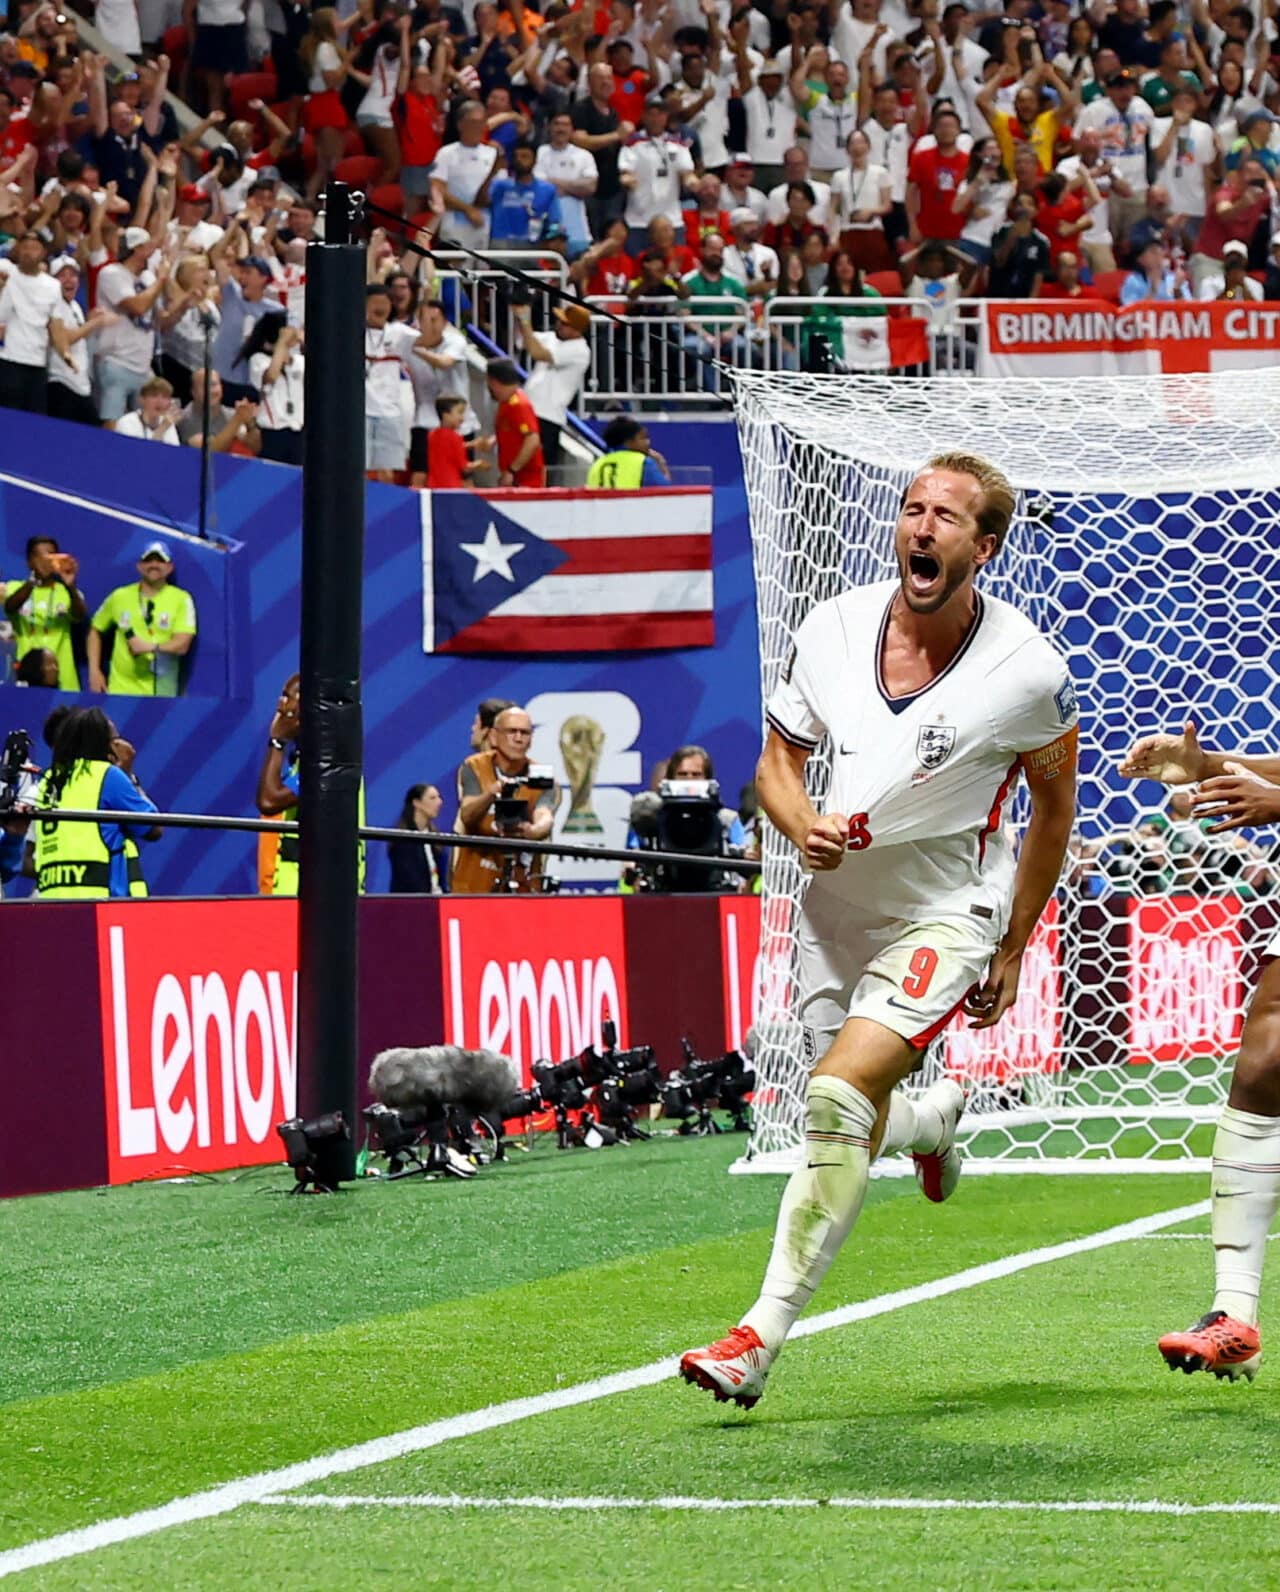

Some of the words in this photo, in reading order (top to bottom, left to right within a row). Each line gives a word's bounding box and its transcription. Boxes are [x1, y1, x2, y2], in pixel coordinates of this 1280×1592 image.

[998, 311, 1211, 345] BIRMINGHAM
[448, 918, 621, 1092] Lenovo
[901, 946, 939, 999] 9
[109, 924, 299, 1157] Lenov
